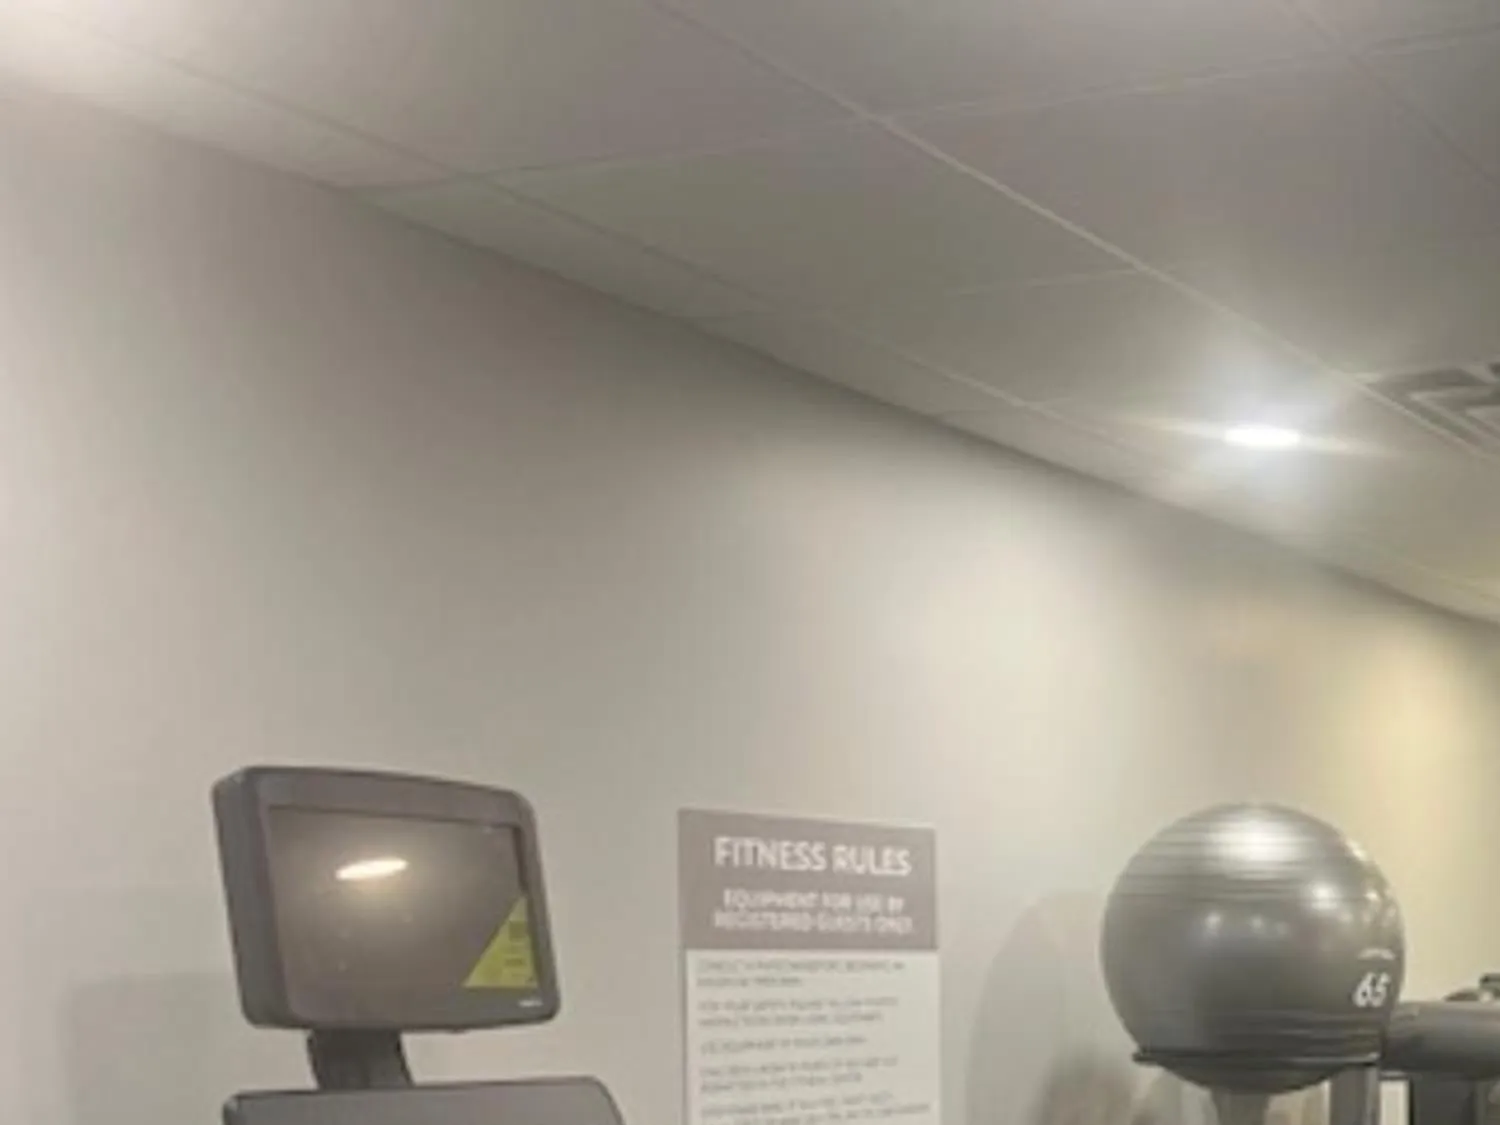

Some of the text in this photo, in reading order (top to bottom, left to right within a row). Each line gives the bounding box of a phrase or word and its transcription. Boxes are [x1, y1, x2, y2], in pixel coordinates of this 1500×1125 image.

[714, 836, 913, 876] FITNESS RULES
[1352, 972, 1390, 1008] 65
